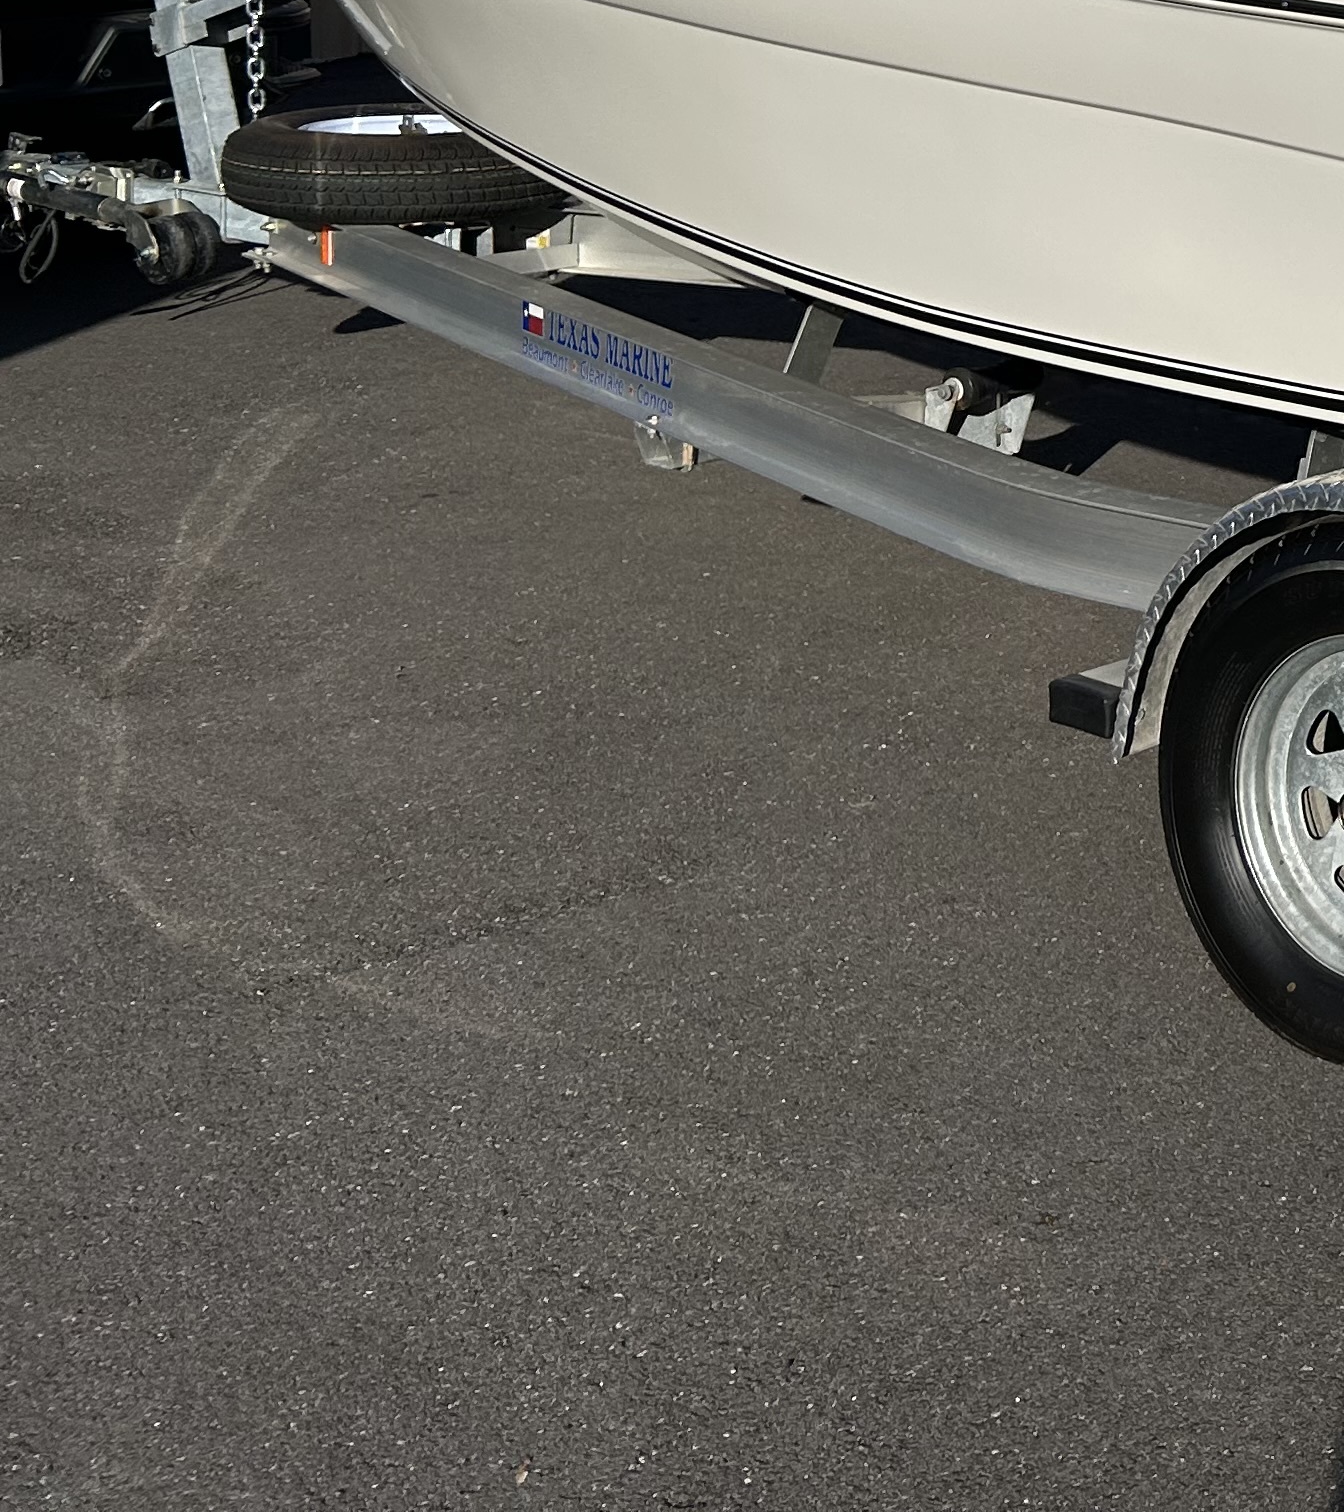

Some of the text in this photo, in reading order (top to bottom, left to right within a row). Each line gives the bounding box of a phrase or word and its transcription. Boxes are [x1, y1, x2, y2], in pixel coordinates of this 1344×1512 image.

[521, 336, 569, 373] Beaumont
[636, 384, 674, 417] Conroe
[548, 311, 674, 389] TEXAS MARINE
